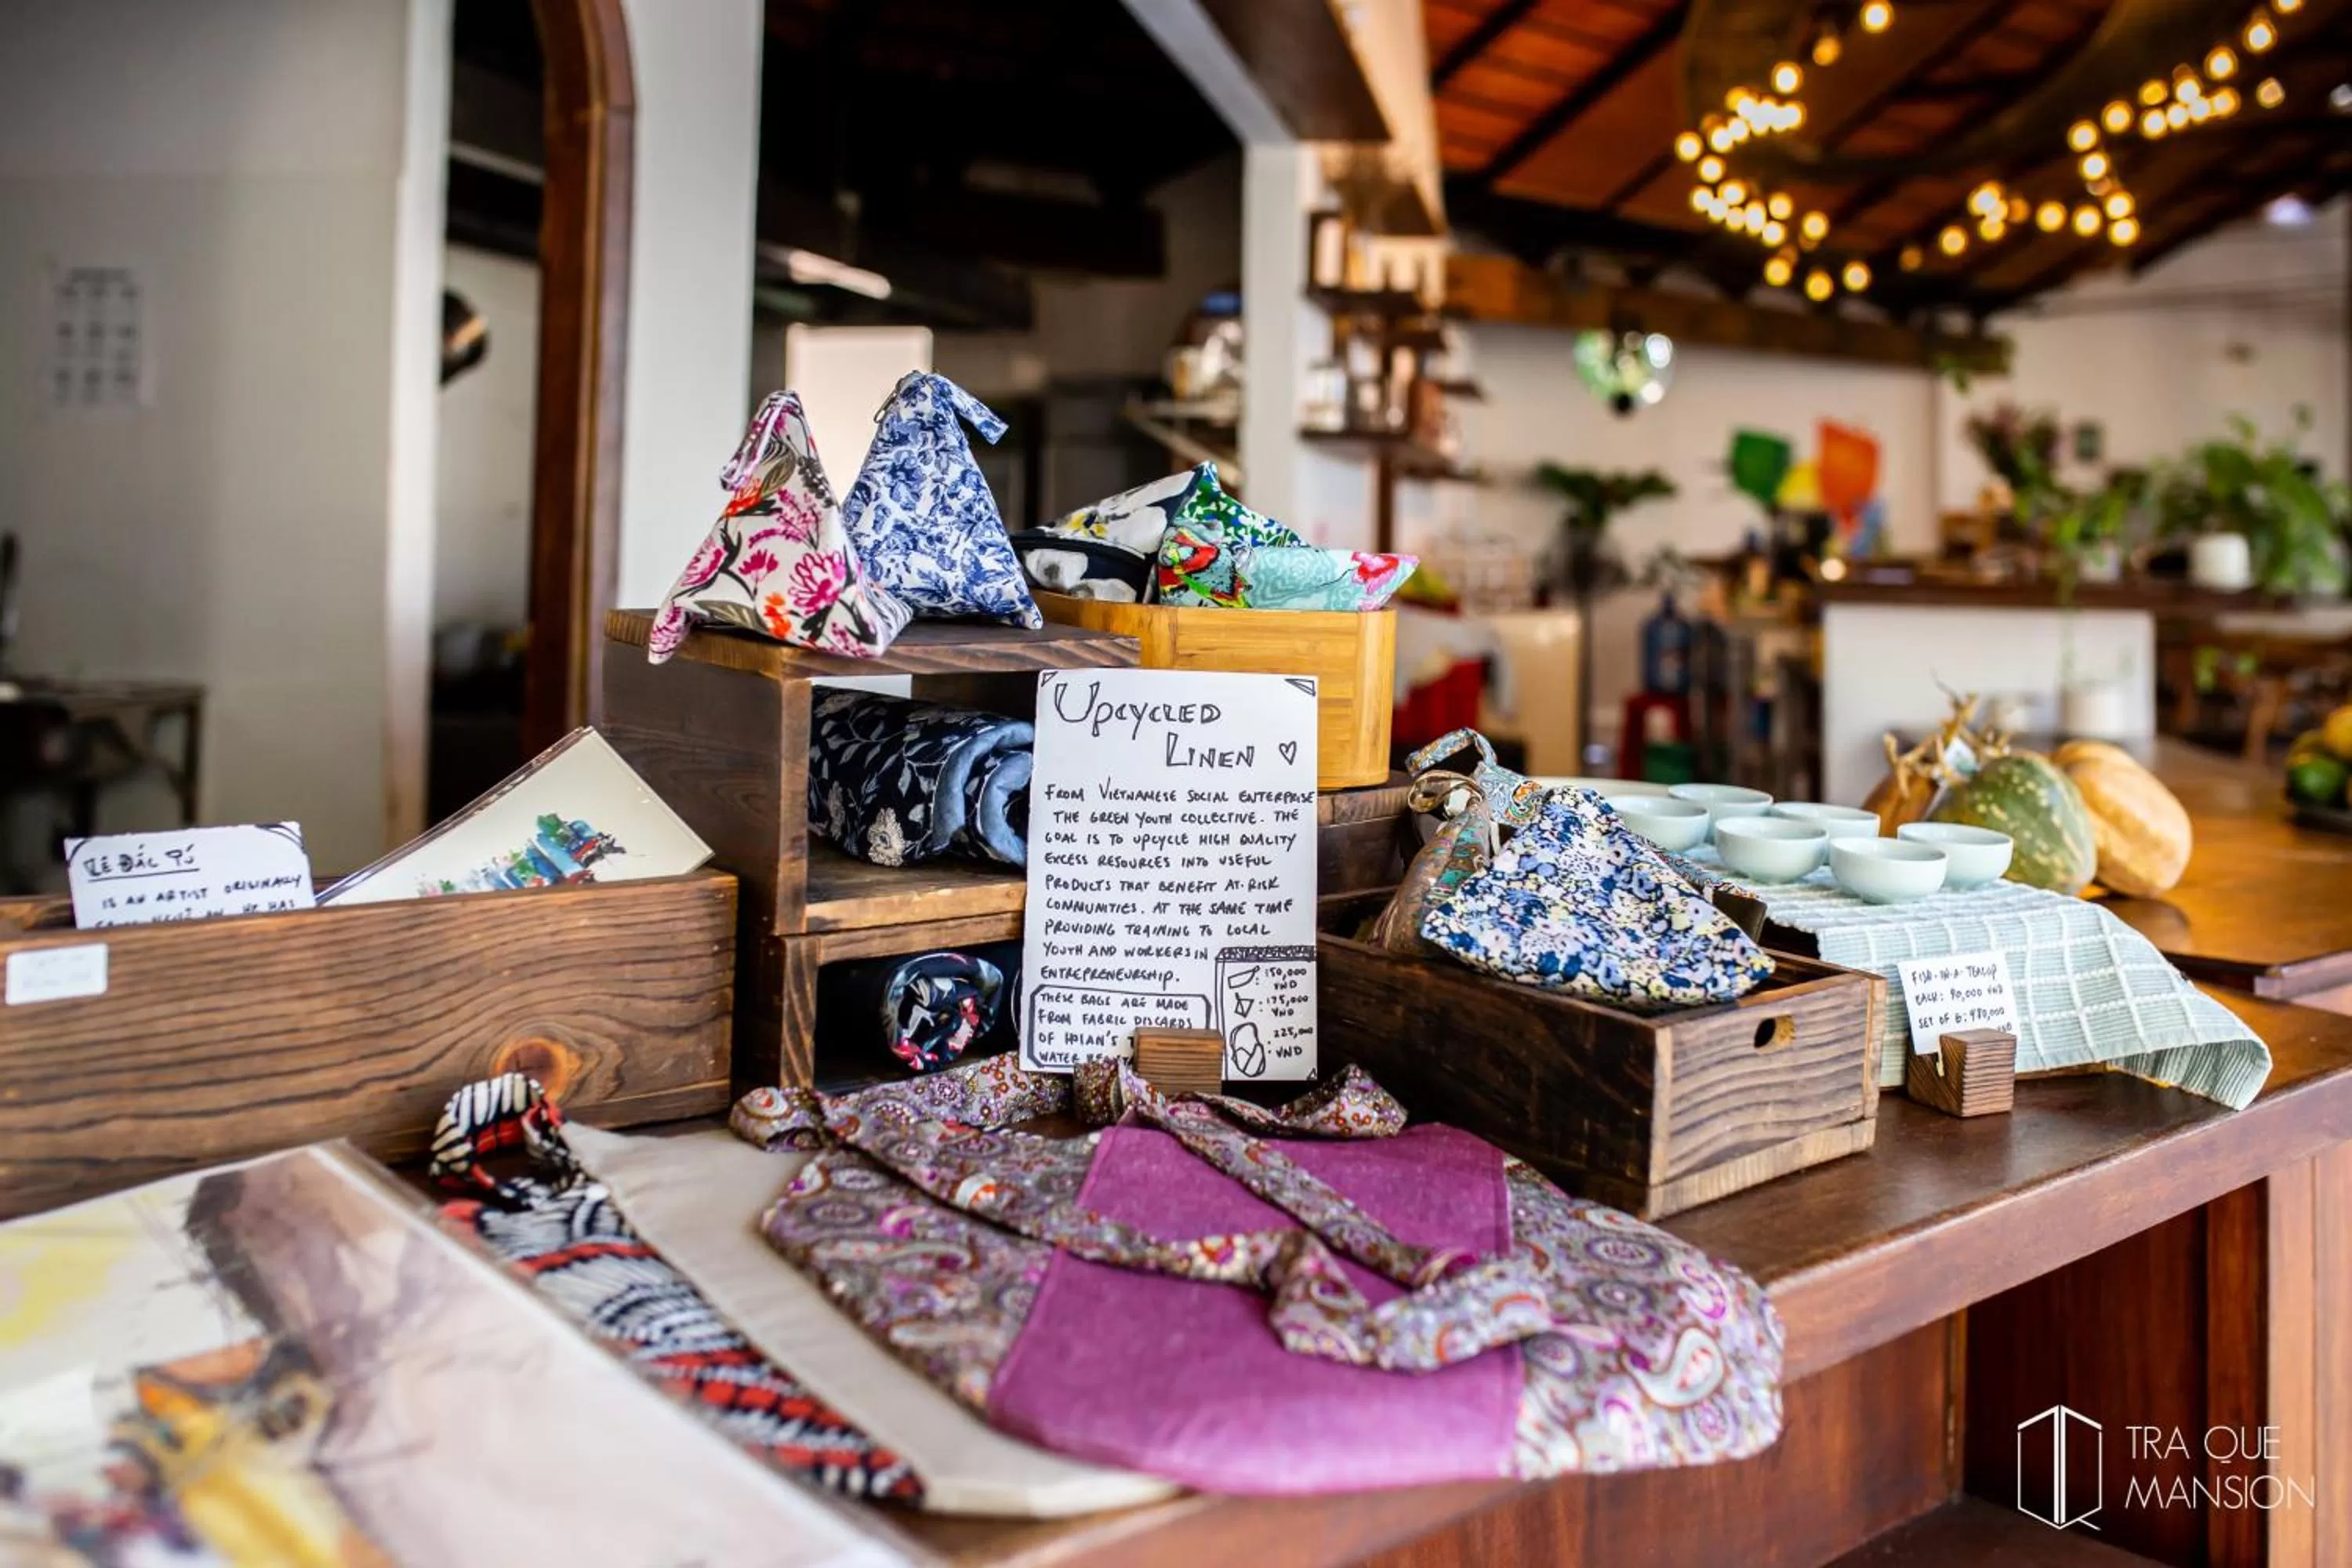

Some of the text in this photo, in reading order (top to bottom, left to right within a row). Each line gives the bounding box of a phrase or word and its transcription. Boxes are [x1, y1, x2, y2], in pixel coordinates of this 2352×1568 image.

[1166, 731, 1256, 769] LINEN
[1044, 775, 1316, 804] FROM VIETNAMESE SOCIAL ENTERPRISE
[1053, 811, 1080, 824] THE
[1090, 811, 1129, 824] GREEN
[1135, 811, 1172, 829] YOUTH
[1273, 808, 1299, 822] THE
[1045, 831, 1077, 844] GOAL
[1087, 833, 1100, 844] IS
[1109, 833, 1123, 846] TO
[1199, 833, 1230, 846] HIGH
[1240, 833, 1298, 852] QUALITY
[1044, 851, 1273, 869] EXCESS RESOURCES INTO USEFUL
[1045, 873, 1112, 892] PRODUCTS
[1119, 880, 1150, 892] THAT
[1158, 880, 1218, 894] BENEFIT
[1152, 901, 1171, 915] AT
[1178, 902, 1202, 916] THE
[1208, 900, 1247, 915] SAME
[1254, 898, 1294, 915] TIME
[1044, 918, 1271, 938] PROVIDING TRAINING TO LOCAL
[1043, 941, 1209, 960] YOUTH AND WORKERS IN
[1273, 980, 1298, 990] VND
[1040, 992, 1189, 1011] THESE BAGS ARE MADE
[1037, 1009, 1192, 1029] FROM FABRIC DISCARDS
[1272, 1007, 1294, 1018] VND
[1039, 1031, 1055, 1045] OF
[1039, 1051, 1080, 1065] WATER
[1275, 1045, 1304, 1058] VND
